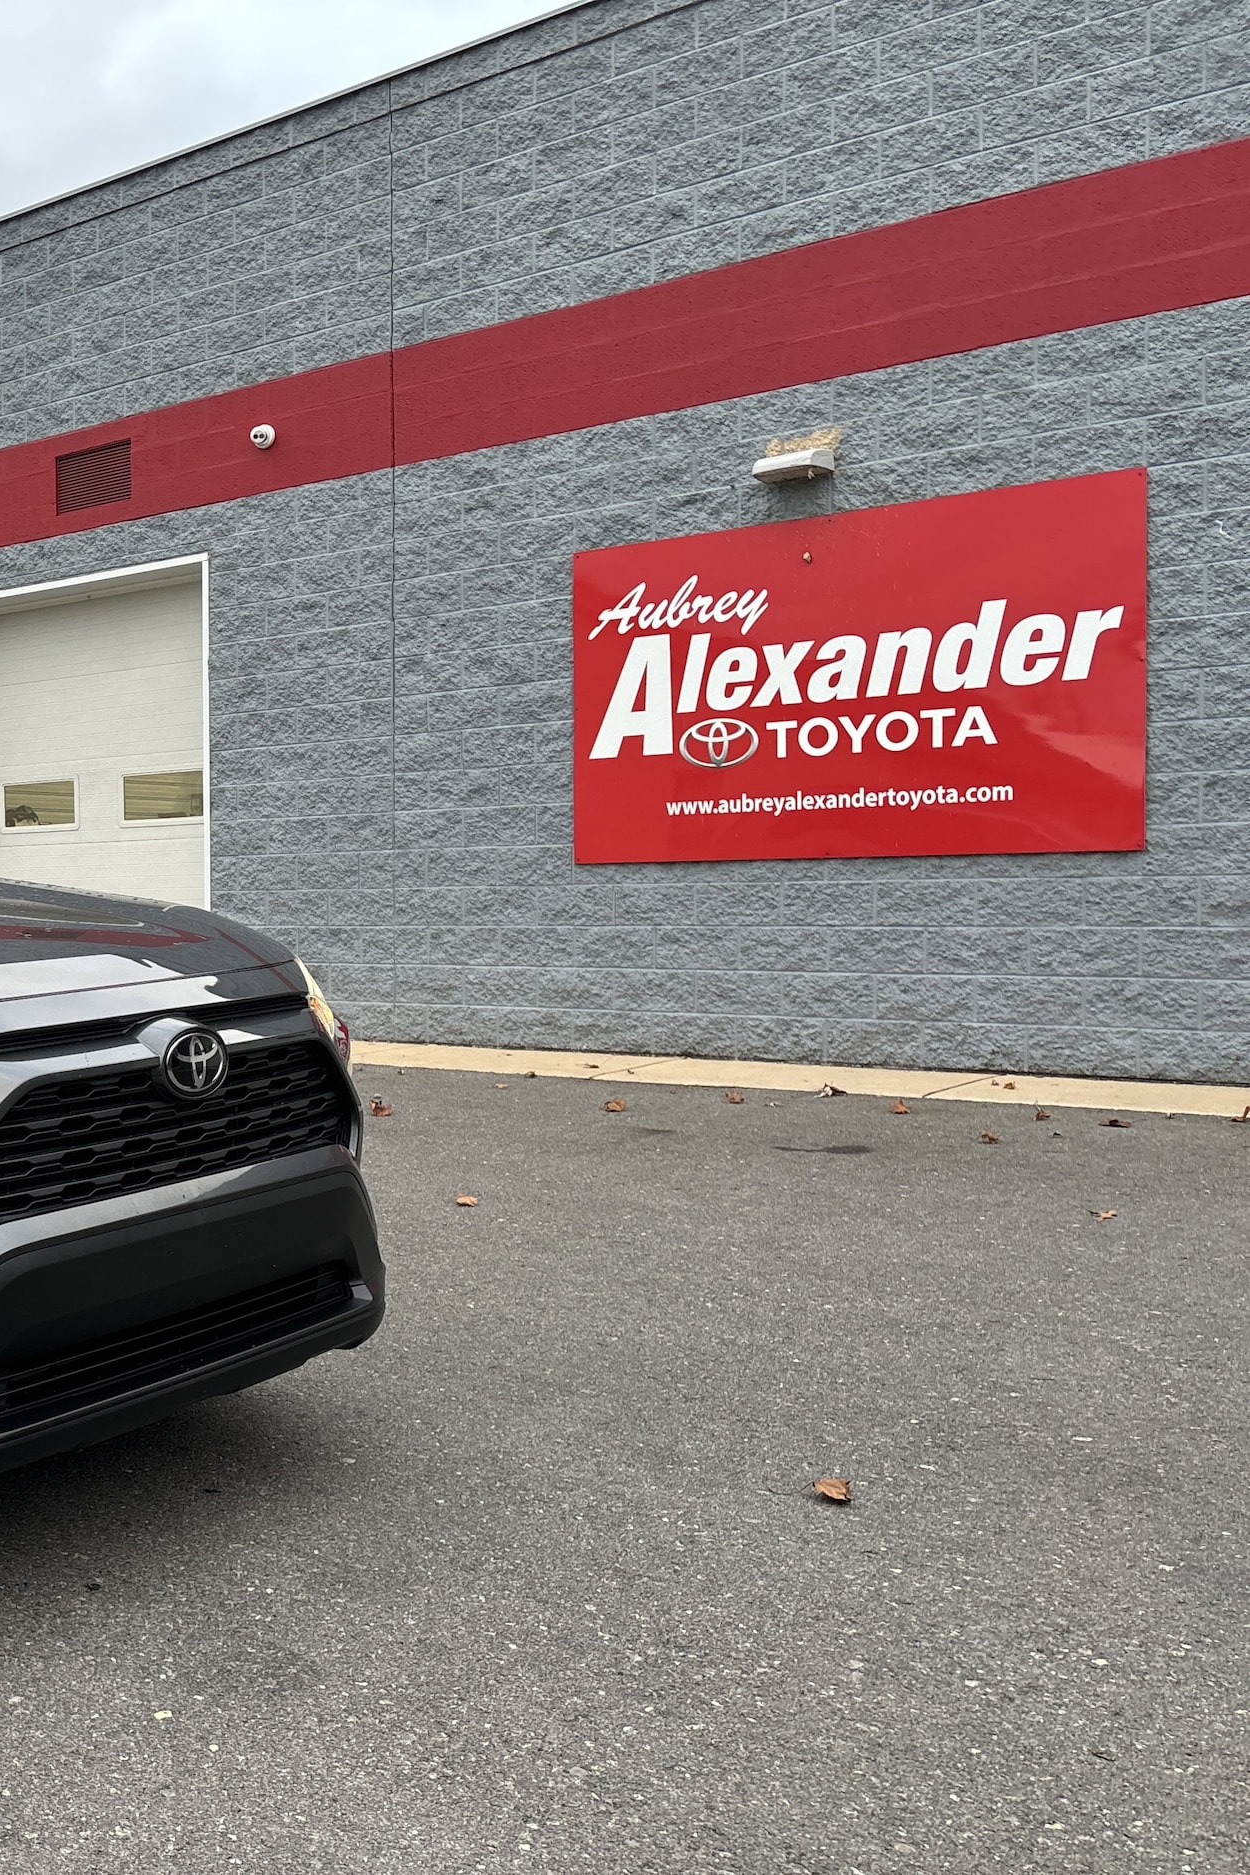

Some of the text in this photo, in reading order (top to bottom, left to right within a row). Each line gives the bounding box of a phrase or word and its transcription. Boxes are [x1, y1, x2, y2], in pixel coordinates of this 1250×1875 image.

[587, 574, 769, 640] Aubrey
[588, 598, 1125, 760] Alexander
[765, 705, 998, 759] TOYOTA
[665, 785, 1014, 817] www.aubreyalexandertoyota.com
